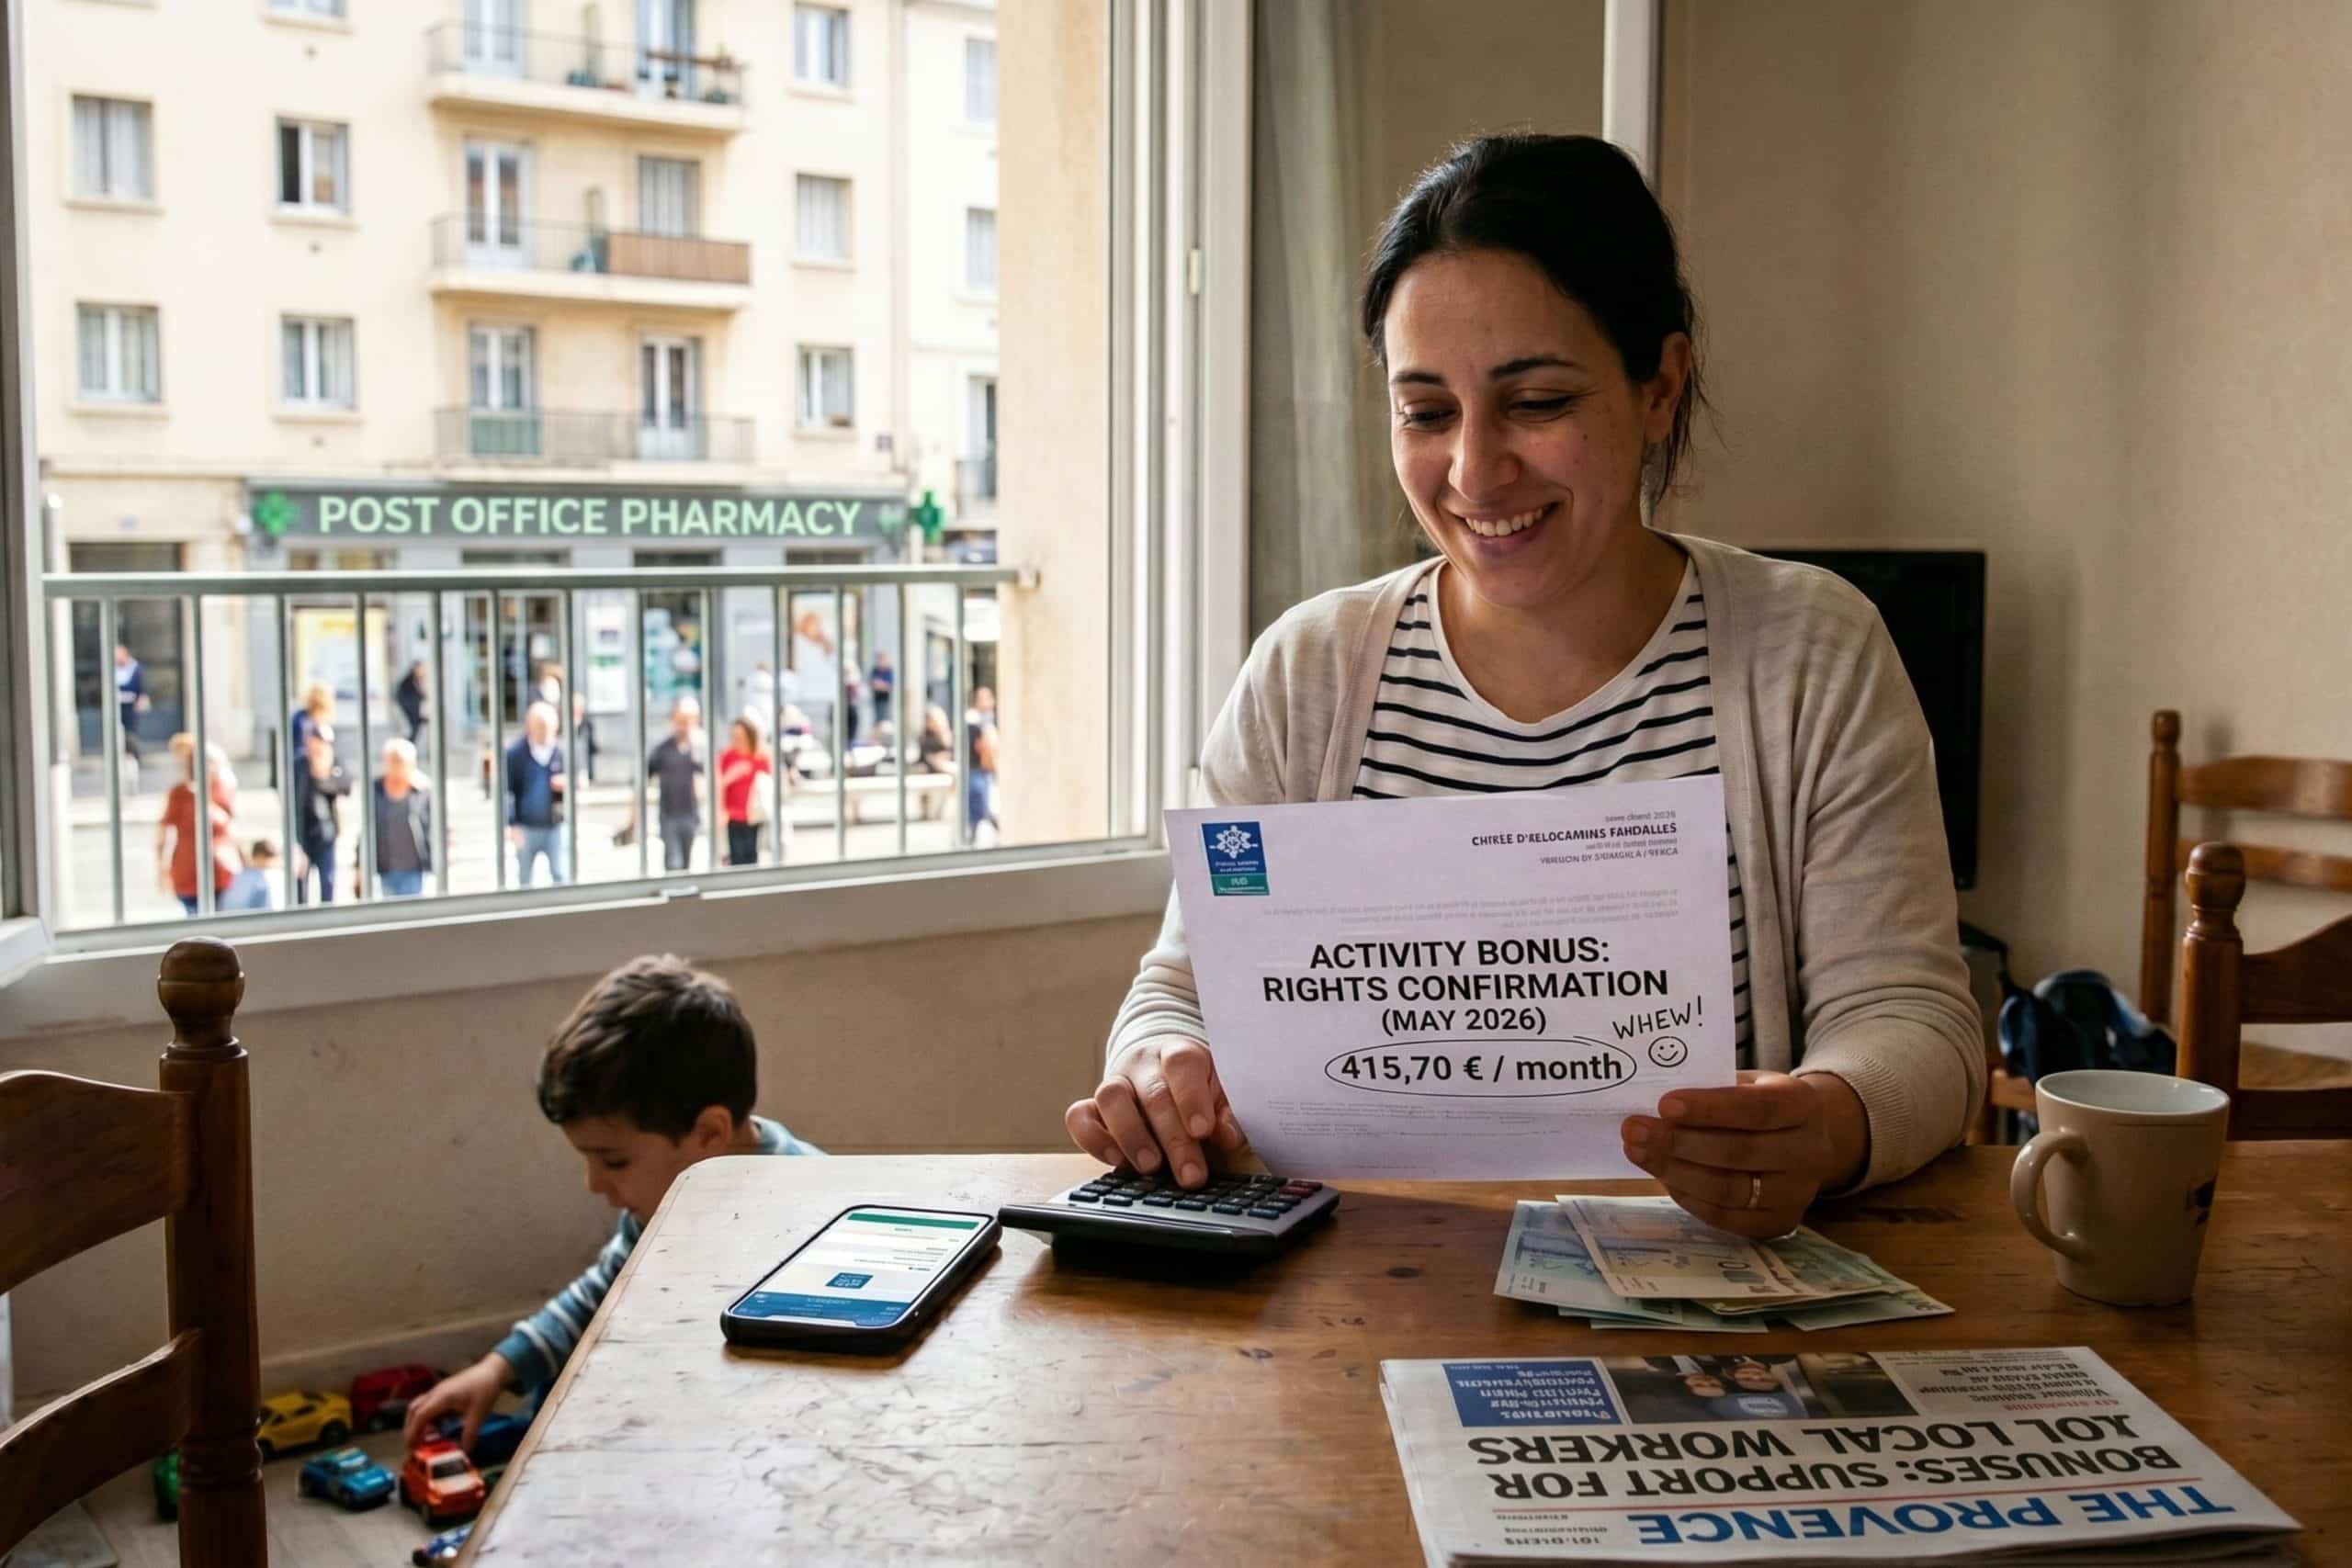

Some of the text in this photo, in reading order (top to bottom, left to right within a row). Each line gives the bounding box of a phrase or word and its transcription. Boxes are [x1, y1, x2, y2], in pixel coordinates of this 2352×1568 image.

[319, 496, 862, 536] POST OFFICE PHARMACY
[1310, 937, 1610, 969] ACTIVITY BONUS:
[1262, 970, 1668, 1002] RIGHTS CONFIRMATION
[1382, 1007, 1547, 1036] (MAY 2026)
[1612, 996, 1704, 1040] WHEW!
[1340, 1053, 1623, 1085] 415,70 € / month
[1468, 1429, 1795, 1464] WORKERS
[1802, 1421, 2014, 1454] LOCAL
[1487, 1444, 2181, 1499] BONUSES: SUPPORT FOR
[1627, 1484, 2235, 1544] THE PROVENCE
